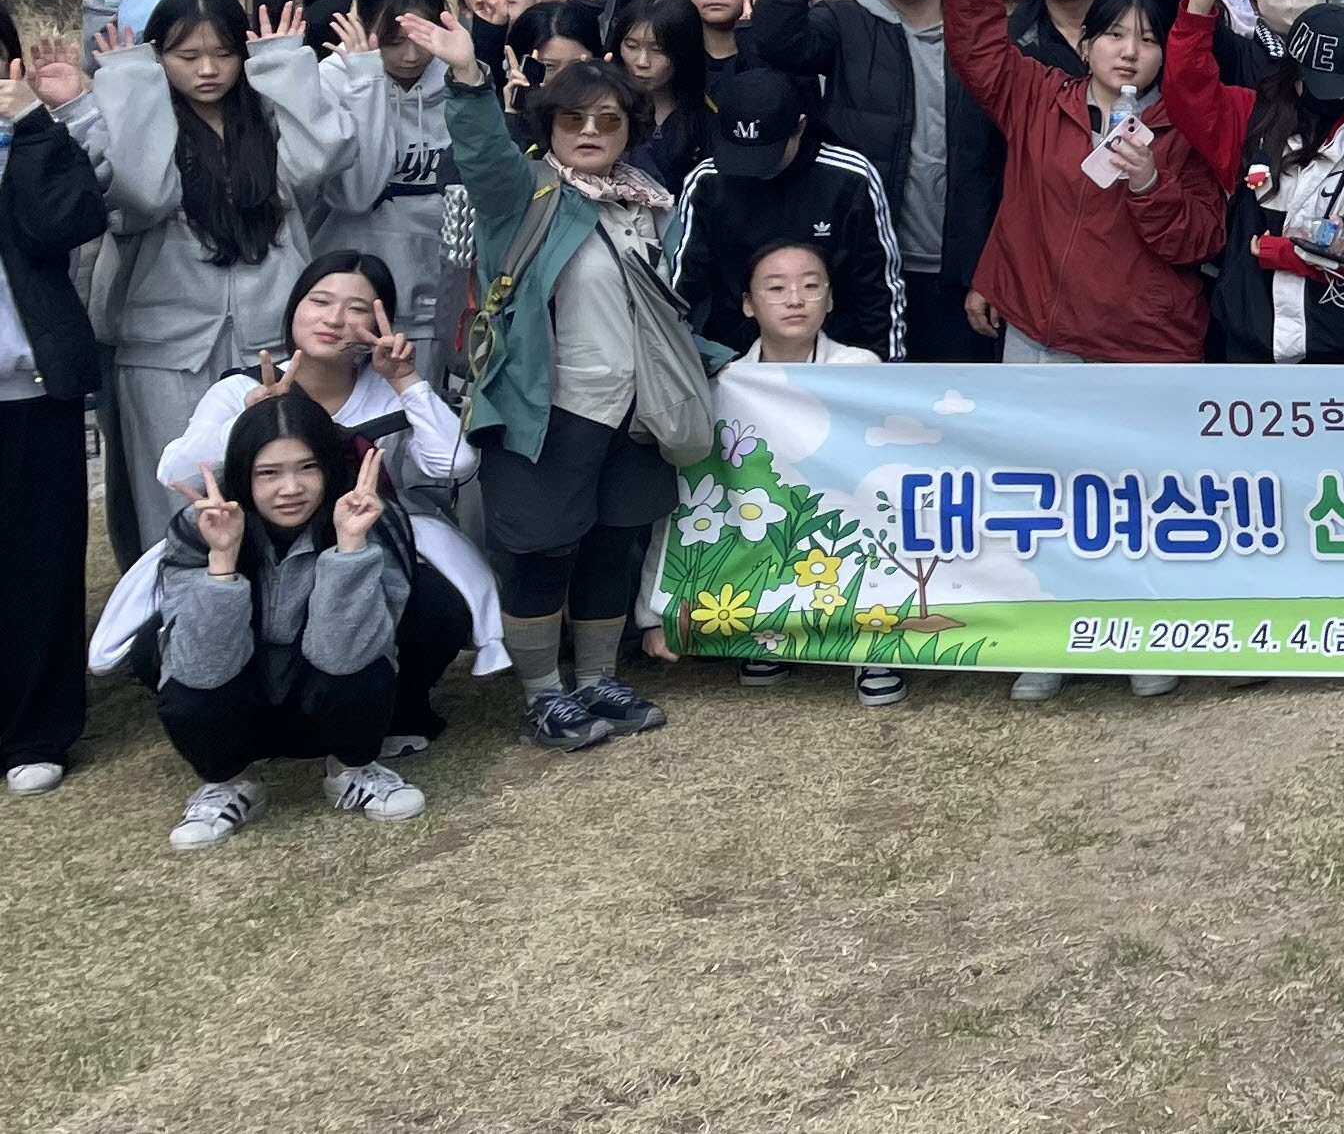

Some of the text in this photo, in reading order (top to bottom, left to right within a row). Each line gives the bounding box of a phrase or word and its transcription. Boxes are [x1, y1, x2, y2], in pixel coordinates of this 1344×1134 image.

[901, 471, 1280, 555] 대구여상!!
[1070, 620, 1142, 650] 일시:
[1150, 622, 1240, 651] 2025.
[1250, 623, 1278, 651] 4.
